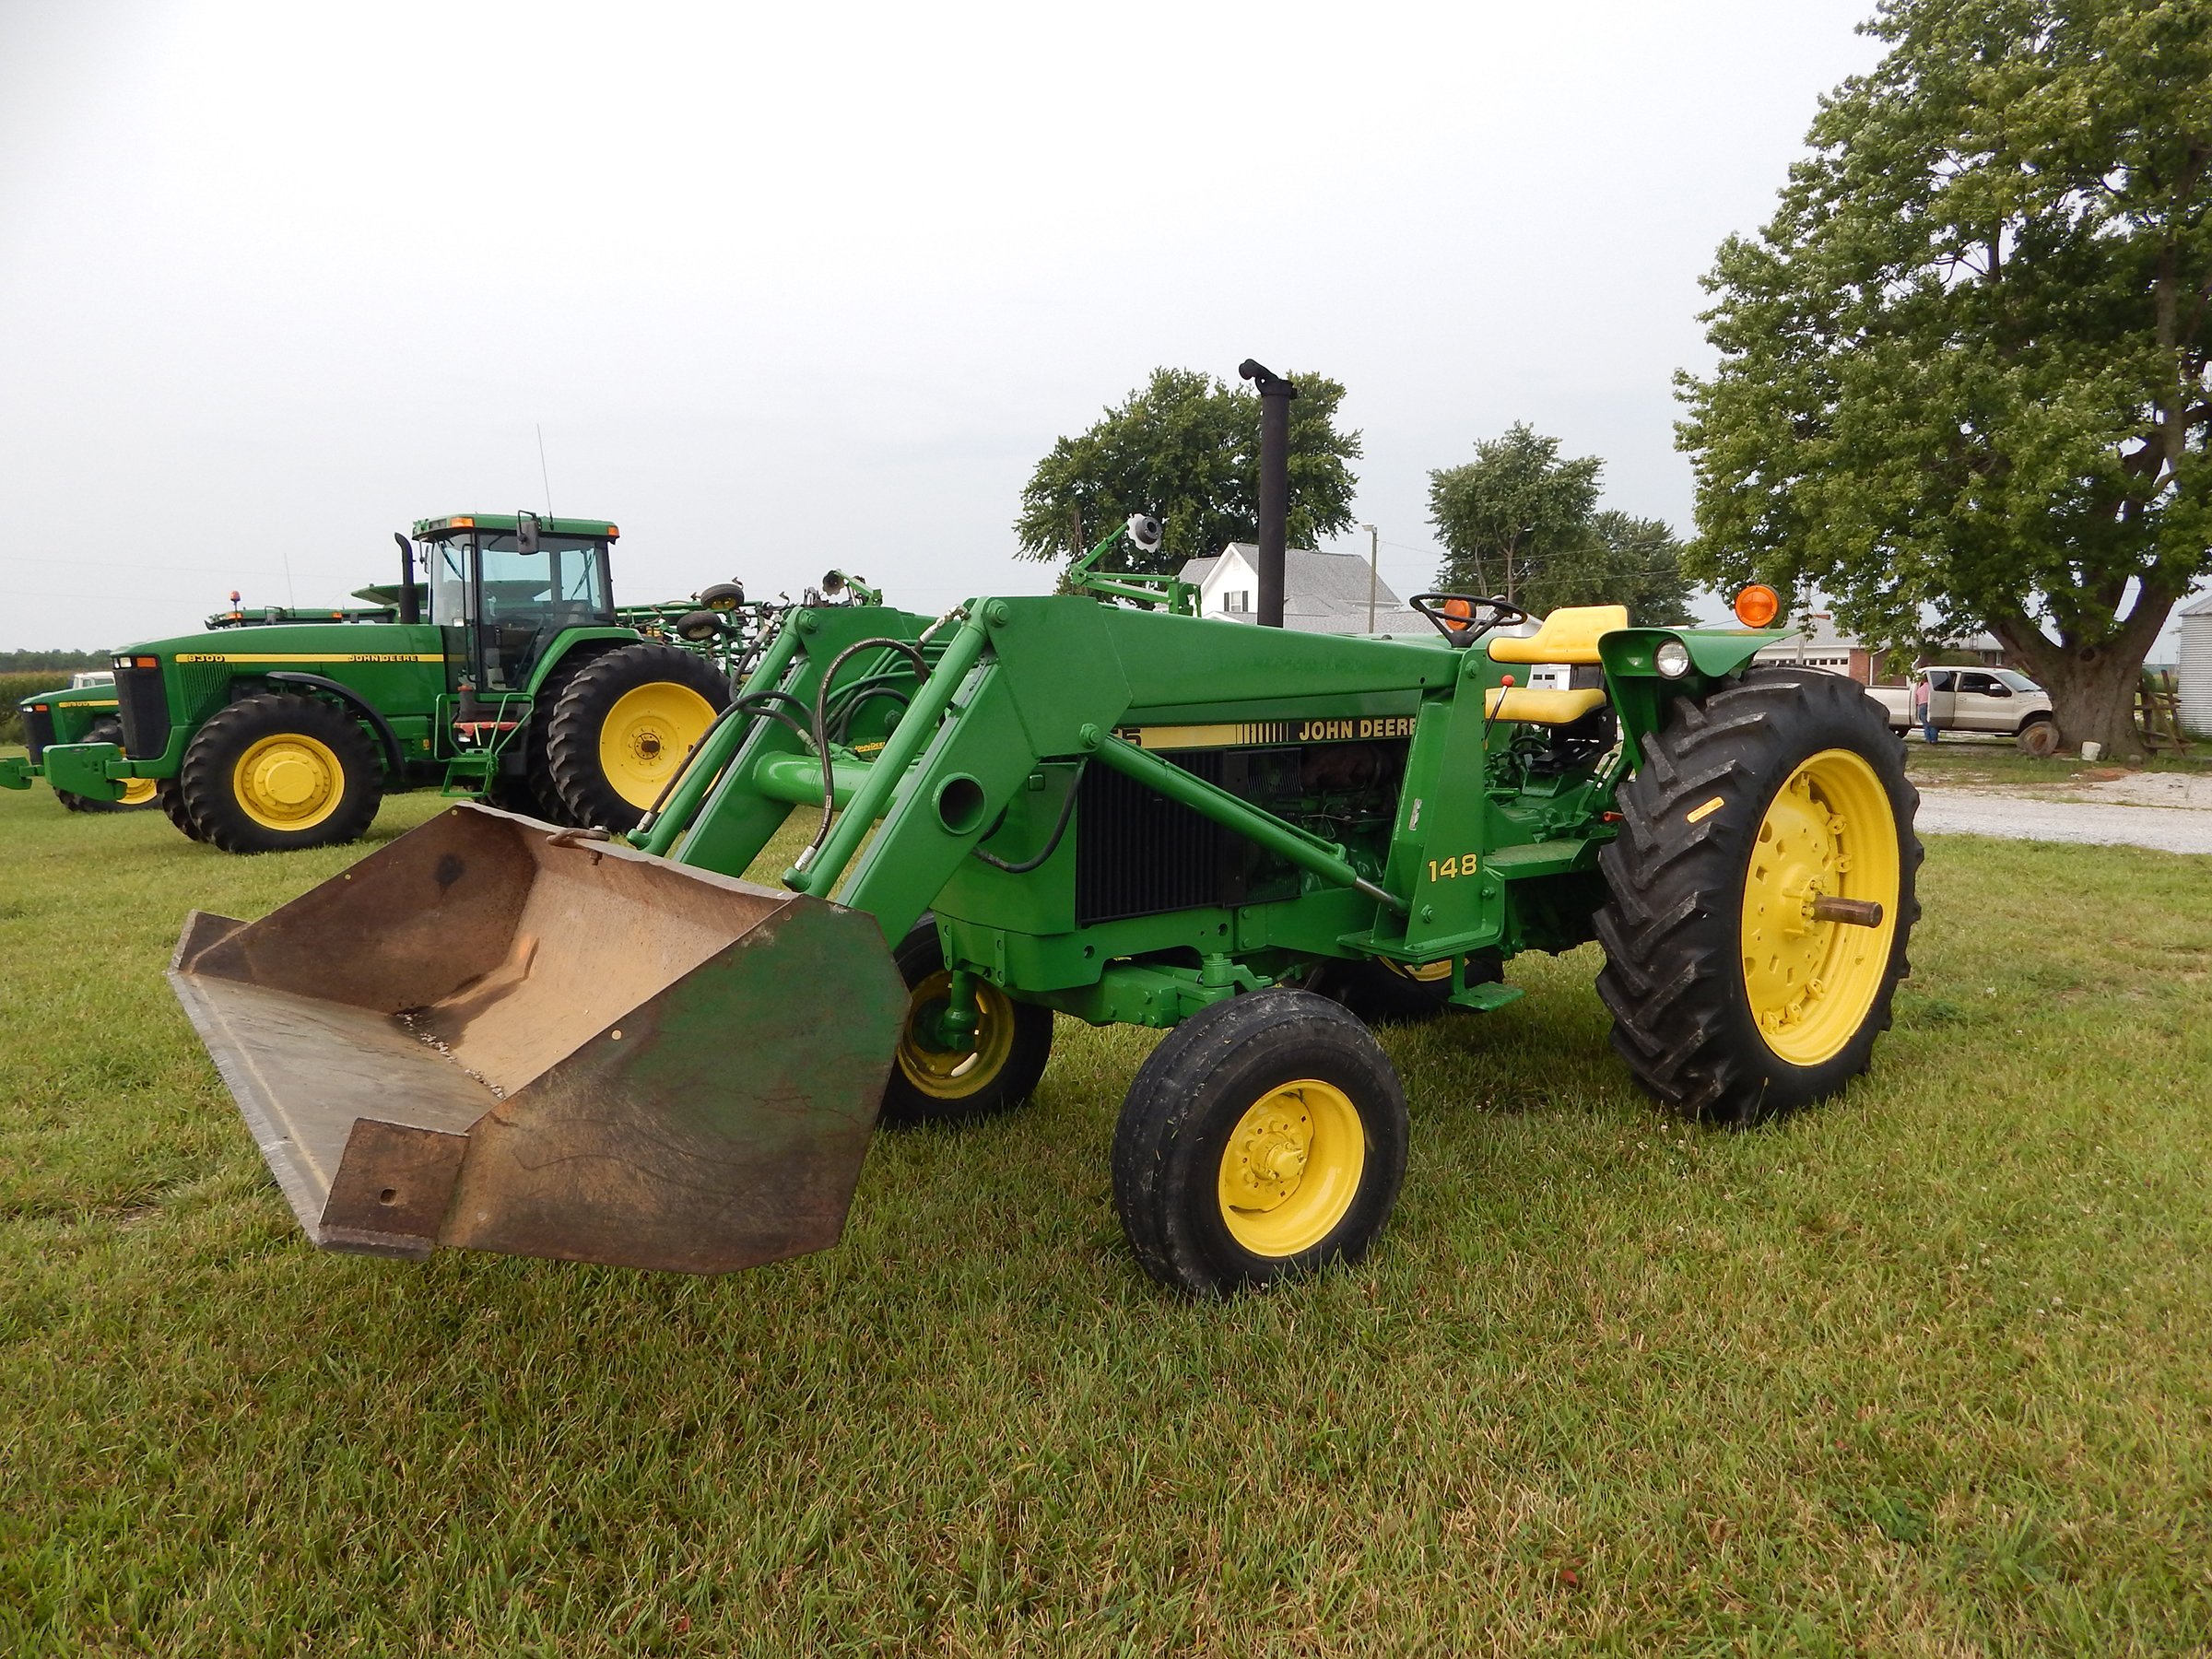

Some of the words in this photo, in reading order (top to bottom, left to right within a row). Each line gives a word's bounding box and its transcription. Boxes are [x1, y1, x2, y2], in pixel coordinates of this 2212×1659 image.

[188, 654, 224, 663] 8300
[382, 653, 419, 662] DEERE
[1299, 721, 1353, 741] JOHN
[1429, 853, 1477, 883] 148
